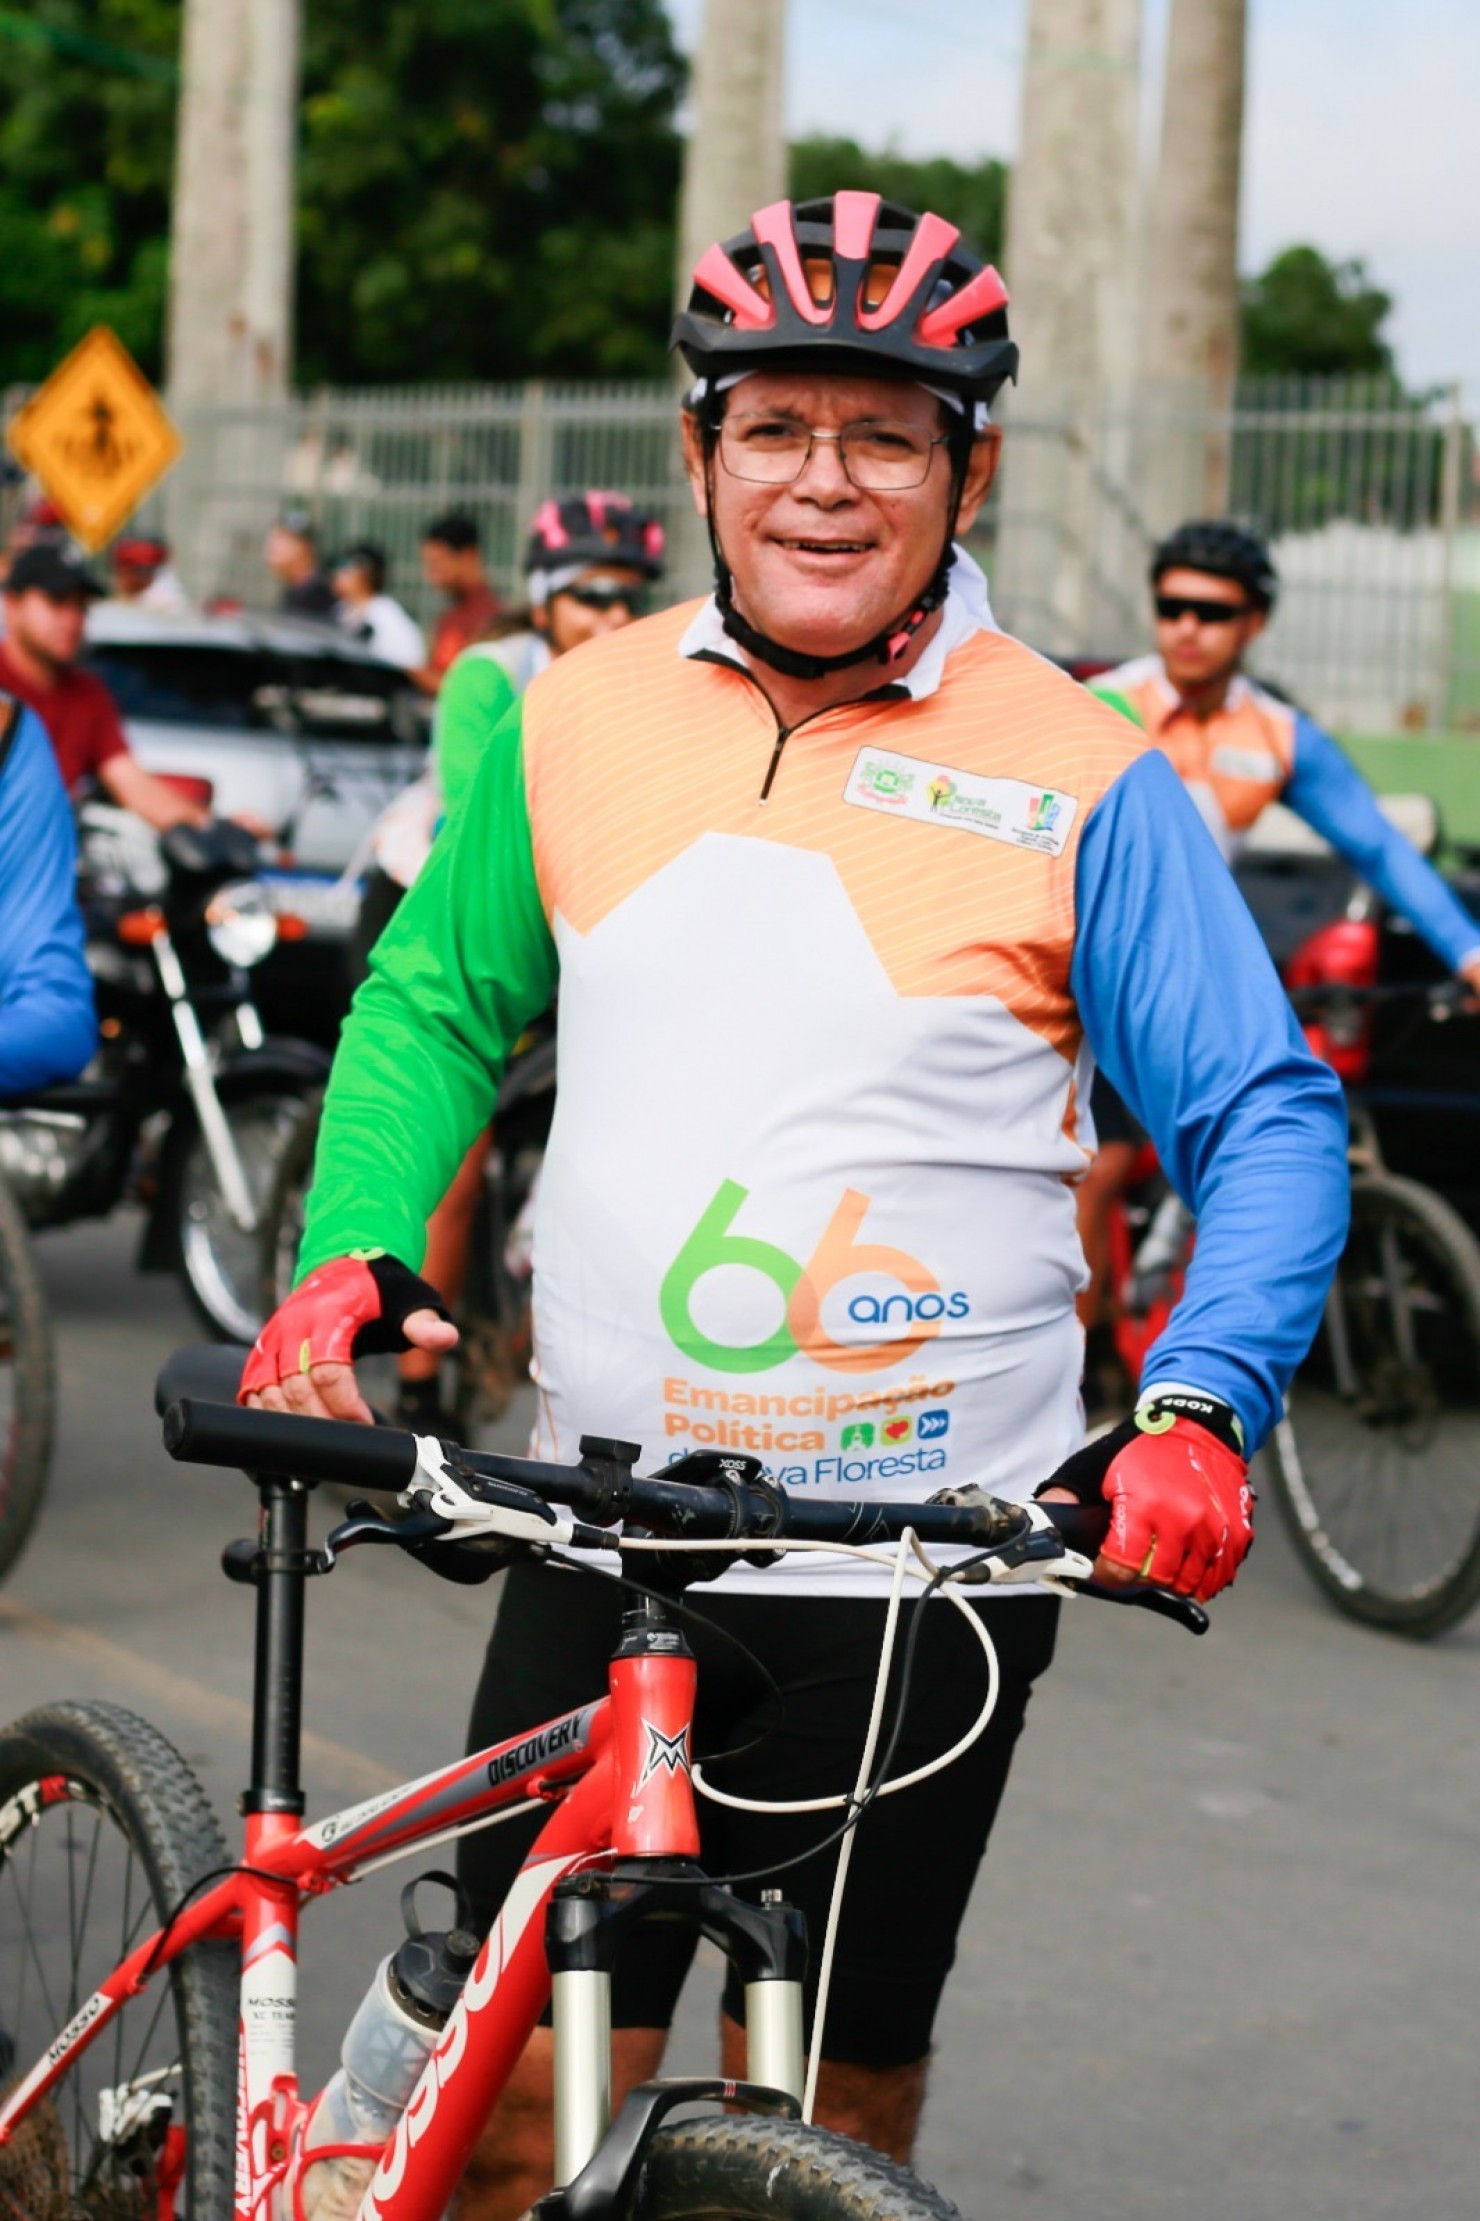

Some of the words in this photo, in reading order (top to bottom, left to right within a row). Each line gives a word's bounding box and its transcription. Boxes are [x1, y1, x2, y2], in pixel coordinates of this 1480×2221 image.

[659, 1177, 941, 1374] 66
[847, 1291, 971, 1324] anos
[663, 1374, 956, 1422] Emancipação
[664, 1412, 826, 1452] Política
[718, 1458, 748, 1471] XOSS
[814, 1447, 947, 1484] Floresta
[487, 1709, 586, 1787] DISCOVERY
